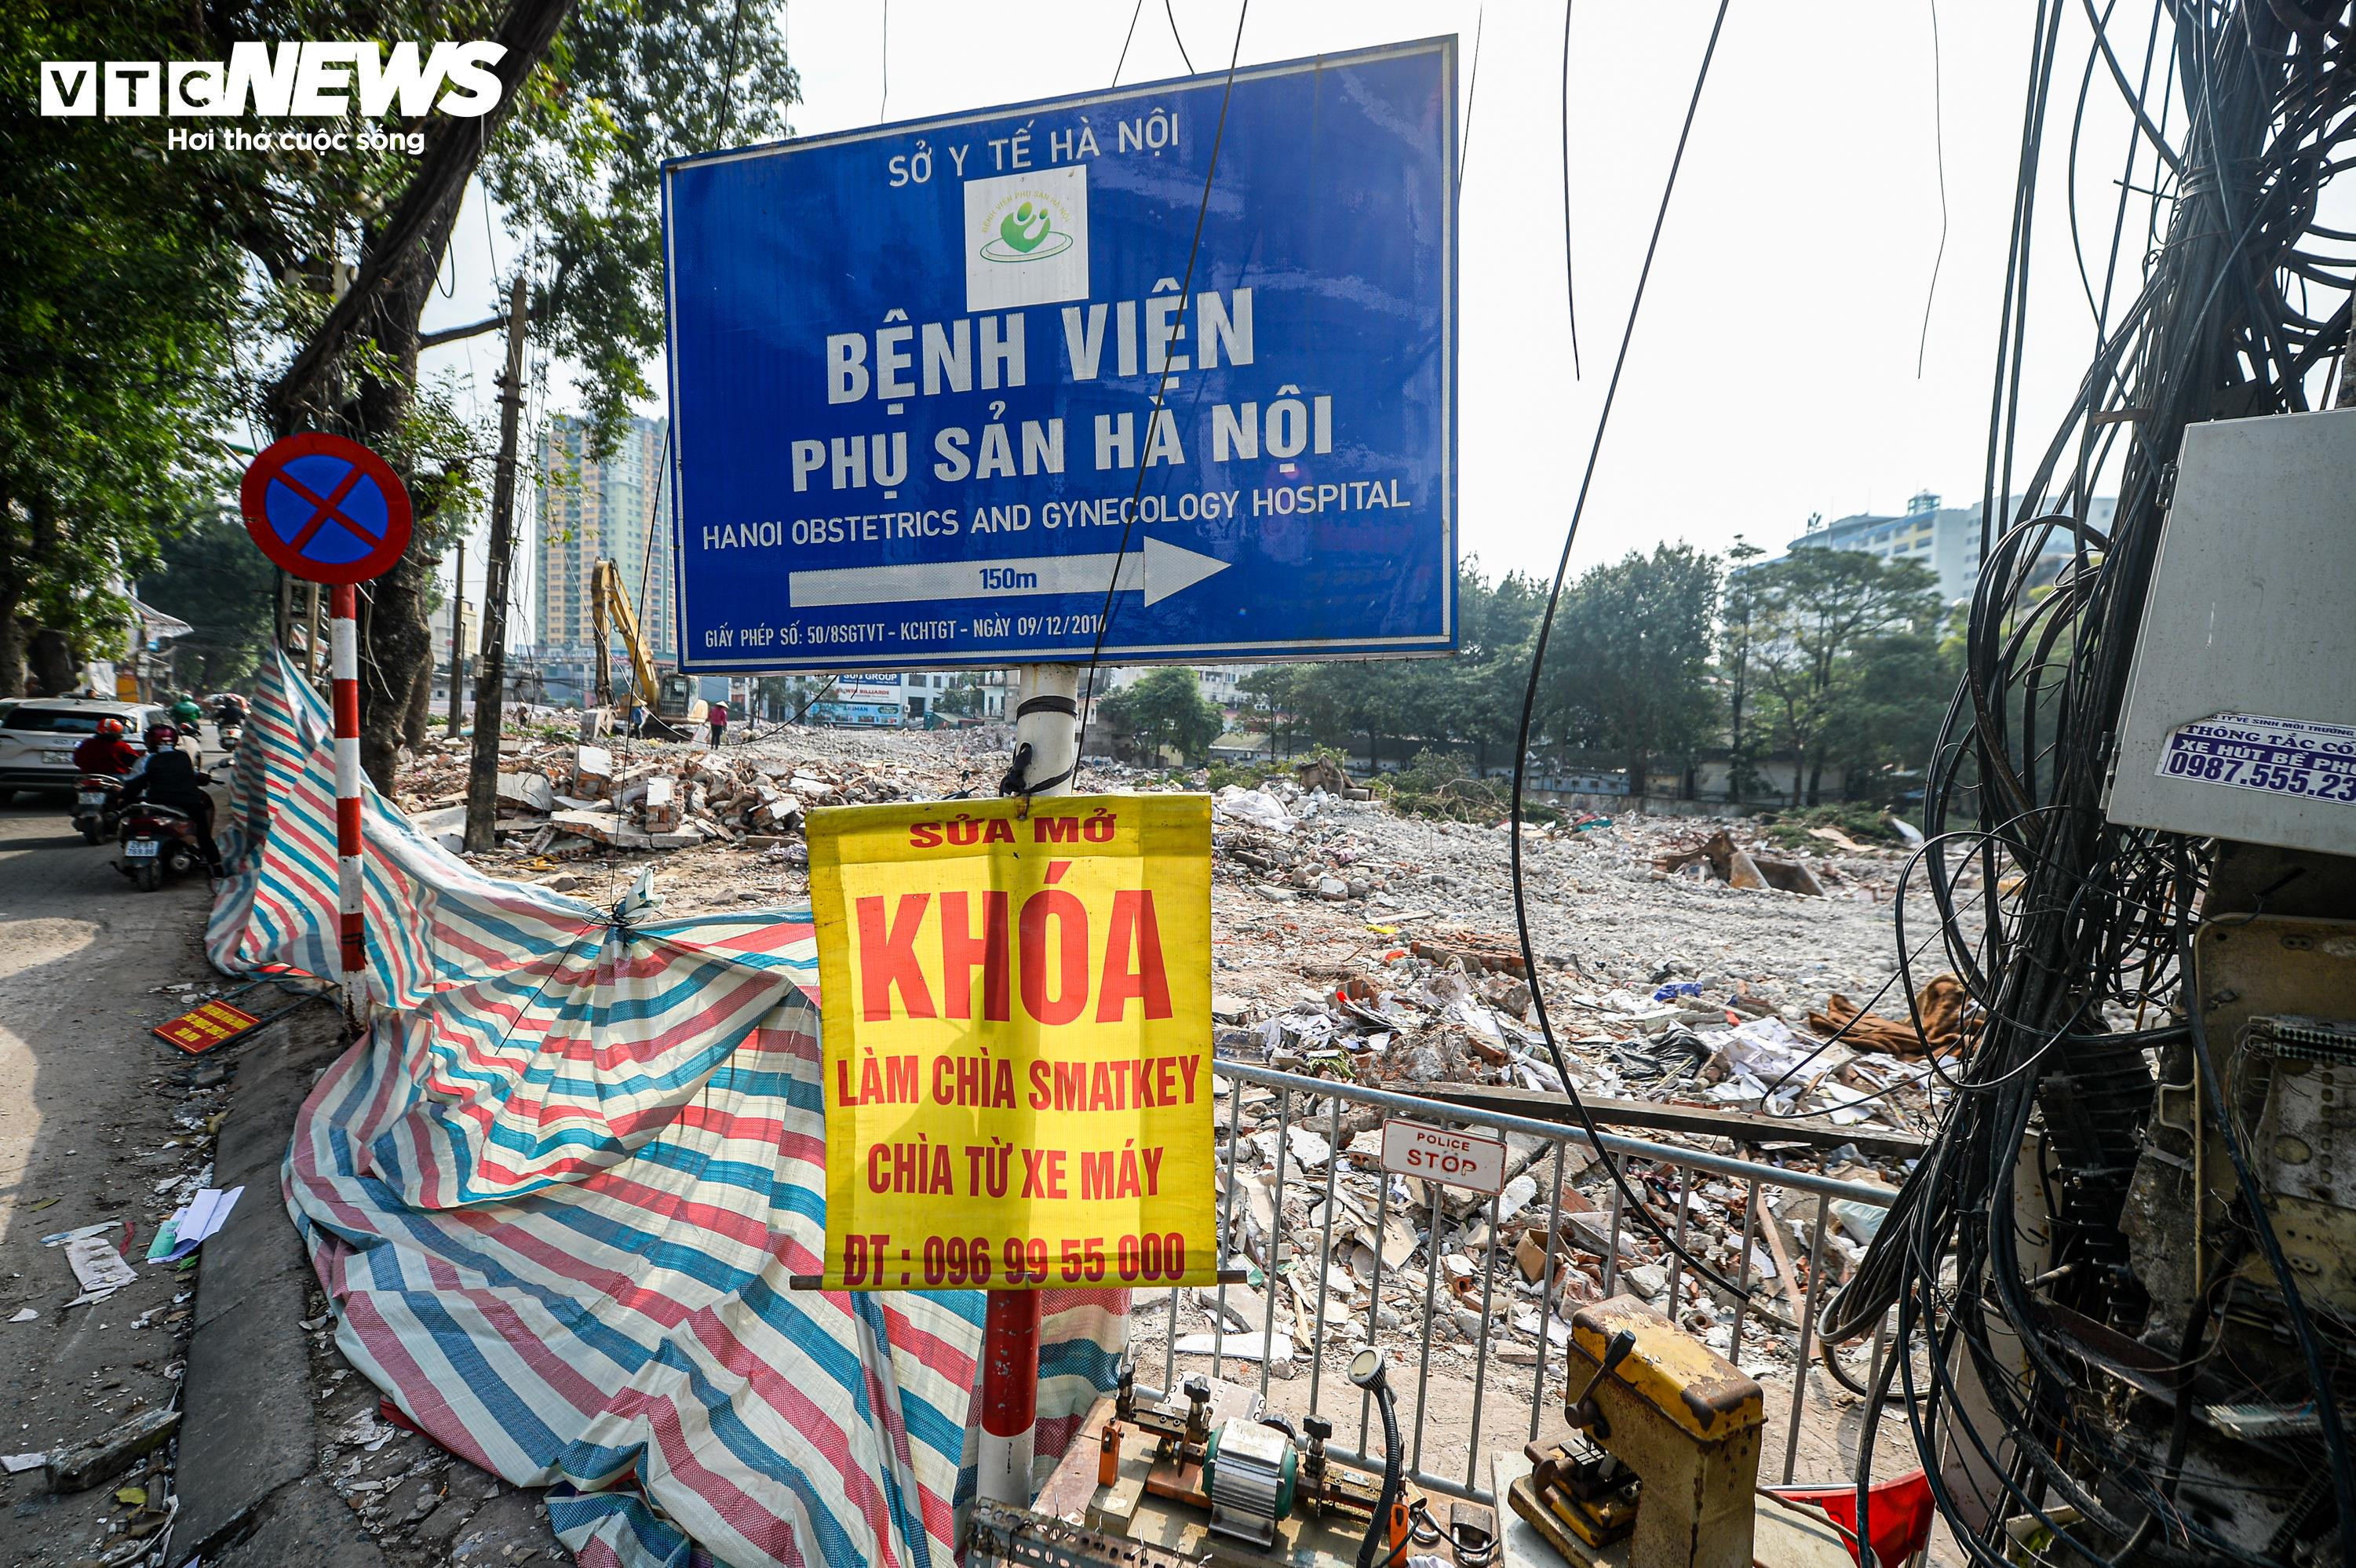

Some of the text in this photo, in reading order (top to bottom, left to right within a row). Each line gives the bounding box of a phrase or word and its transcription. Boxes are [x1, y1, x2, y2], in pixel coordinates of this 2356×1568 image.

[889, 107, 1179, 187] SỞ Y TẾ HÀ NỘI
[826, 277, 1254, 415] BỆNH VIỆN
[791, 384, 1333, 499] PHỤ SẢN HÀ NỘI
[702, 478, 1412, 551] HANOI OBSTETRICS AND GYNECOLOGY HOSPITAL
[978, 567, 1038, 590] 150m
[705, 622, 734, 648] GIẤY
[740, 622, 775, 647] PHÉP
[779, 619, 803, 646] SỐ:
[900, 619, 957, 642] KCHTGT
[972, 611, 1012, 638] NGÀY
[2186, 724, 2356, 755] THÔNG TẮC CỐ
[2252, 718, 2279, 727] SINH
[2179, 738, 2211, 753] XE
[2216, 745, 2266, 760] HÚT
[2270, 751, 2309, 768] BỂ
[909, 808, 1118, 848] SỬA MỞ
[855, 860, 1174, 1026] KHÓA
[837, 1046, 1201, 1111] LÀM CHÌA SMATKEY
[1407, 1149, 1477, 1176] STOP
[1416, 1132, 1471, 1152] POLICE
[867, 1132, 1165, 1201] CHÌA TỪ XE MÁY
[923, 1234, 991, 1286] 096
[1003, 1236, 1049, 1285] 99
[1060, 1236, 1106, 1283] 55
[1117, 1231, 1186, 1282] 000
